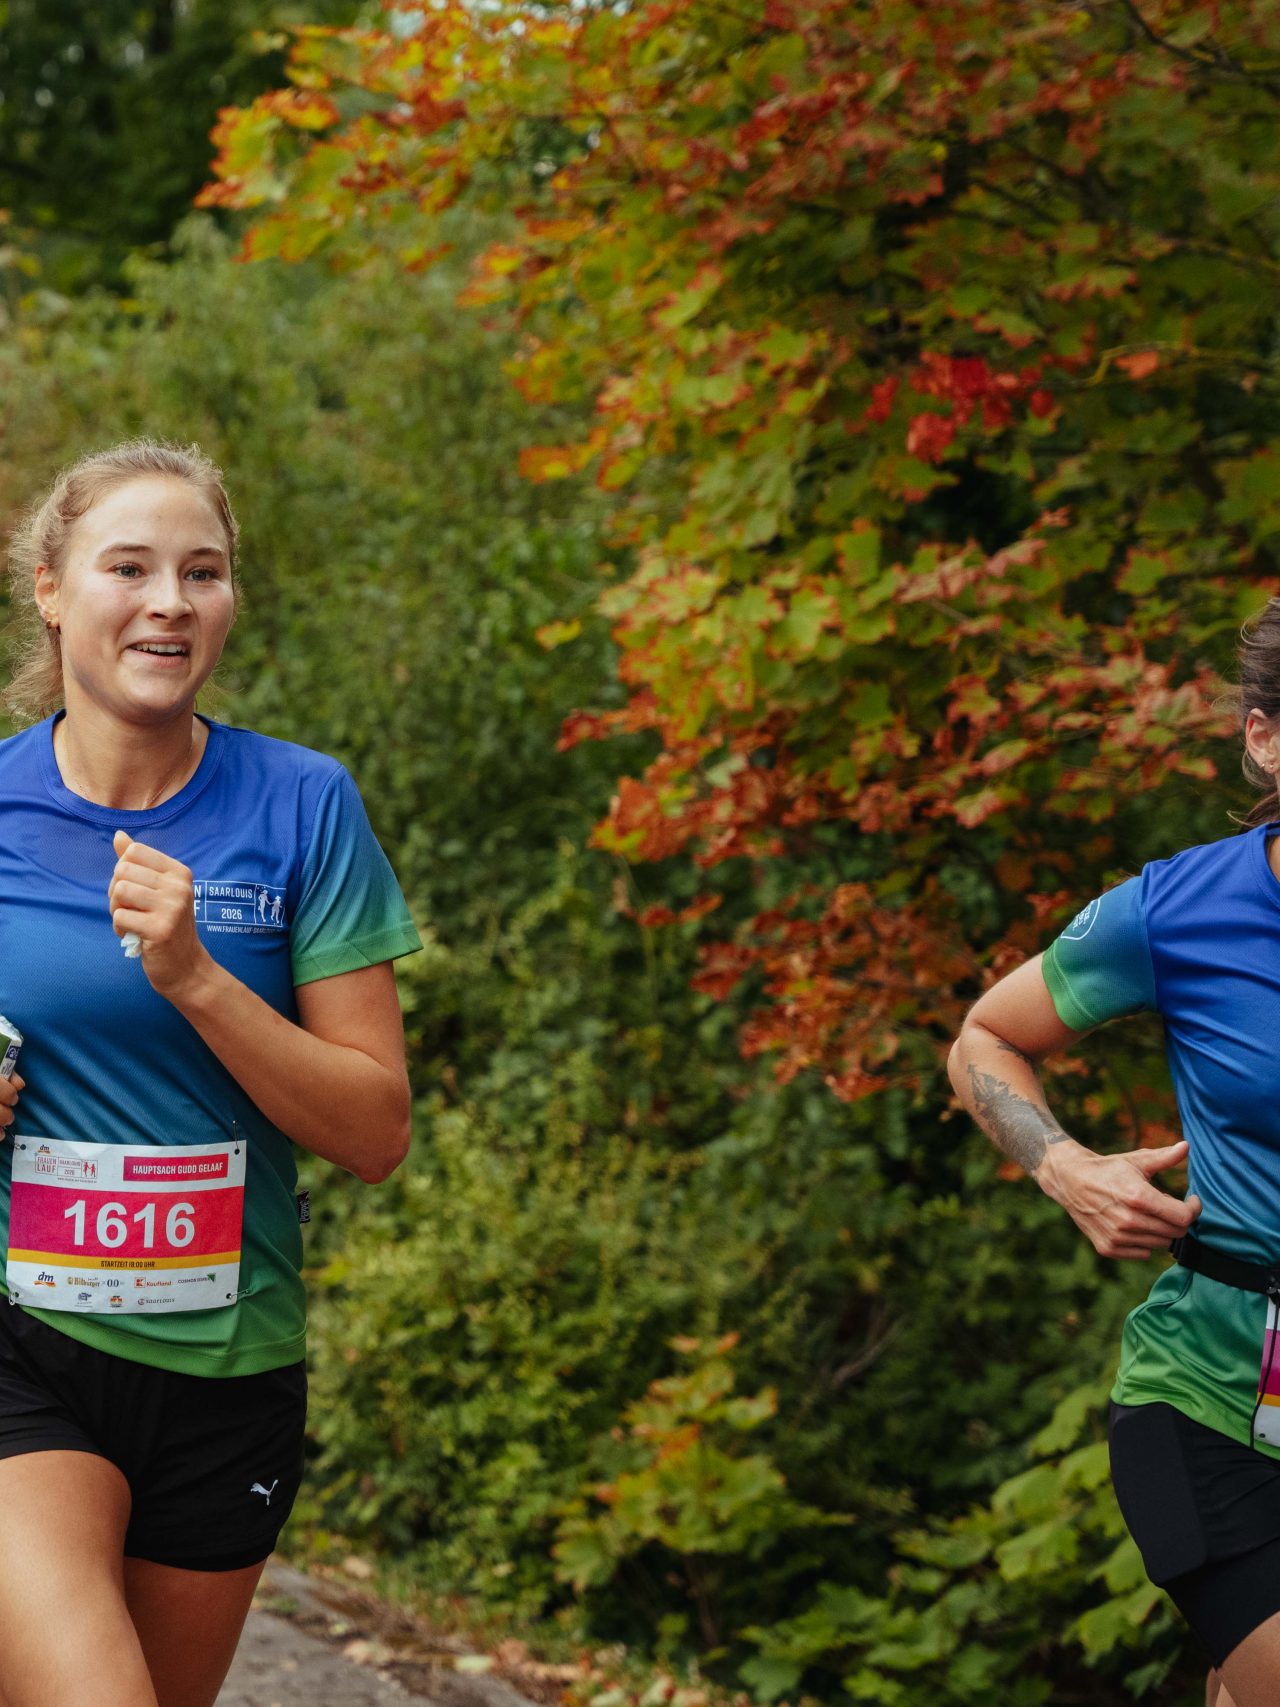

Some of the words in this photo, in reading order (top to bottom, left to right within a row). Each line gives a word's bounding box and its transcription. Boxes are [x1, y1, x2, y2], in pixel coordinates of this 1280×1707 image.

[208, 886, 253, 899] SAARLOUIS
[221, 907, 243, 920] 2026
[37, 1164, 57, 1173] LAUF
[132, 1164, 176, 1175] HAUPTSACH
[177, 1165, 197, 1175] GUDD
[198, 1162, 223, 1173] GELAAF
[64, 1199, 195, 1249] 1616
[100, 1260, 128, 1268] STARTZEIT
[37, 1271, 54, 1282] dm
